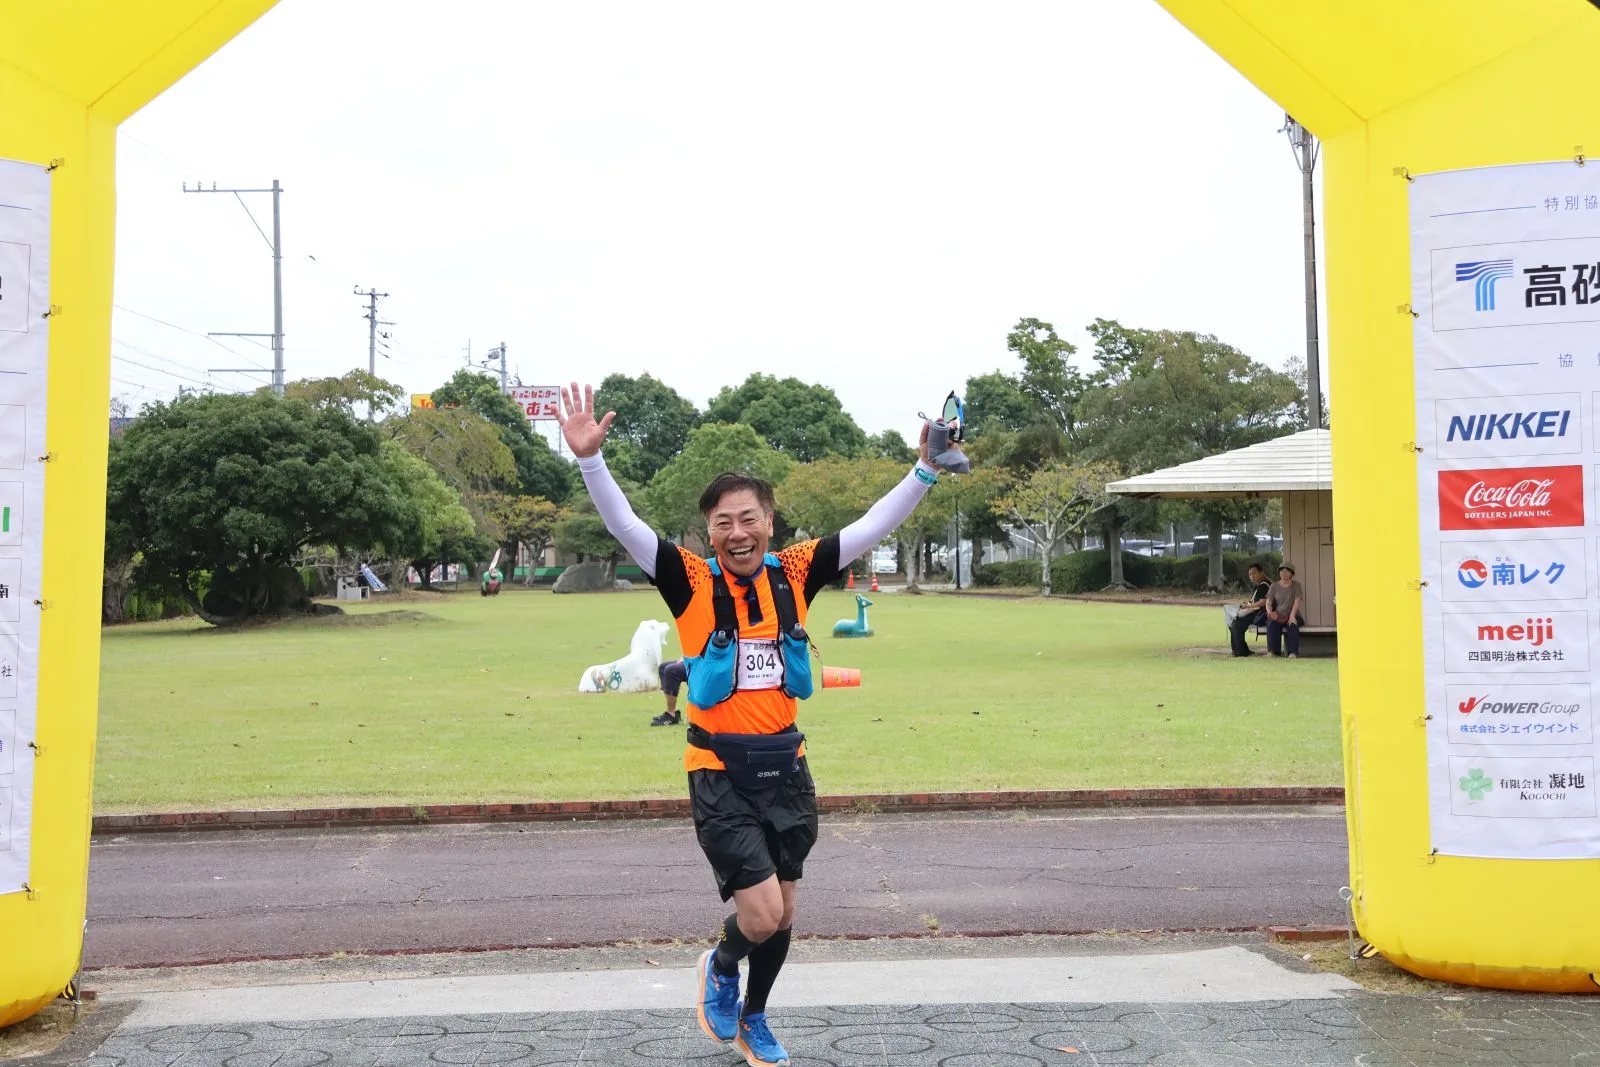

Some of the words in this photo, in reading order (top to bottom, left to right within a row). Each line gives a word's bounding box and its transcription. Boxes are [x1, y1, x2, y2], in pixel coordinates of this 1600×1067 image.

[1446, 410, 1571, 442] NIKKEI
[1464, 478, 1555, 509] Coca-Cola
[1464, 511, 1507, 519] BOTTLERS
[1509, 510, 1535, 518] JAPAN
[1492, 562, 1566, 586] 南レク
[1478, 617, 1553, 646] meiji
[746, 653, 776, 671] 304
[1468, 649, 1565, 663] 四国明治株式会社
